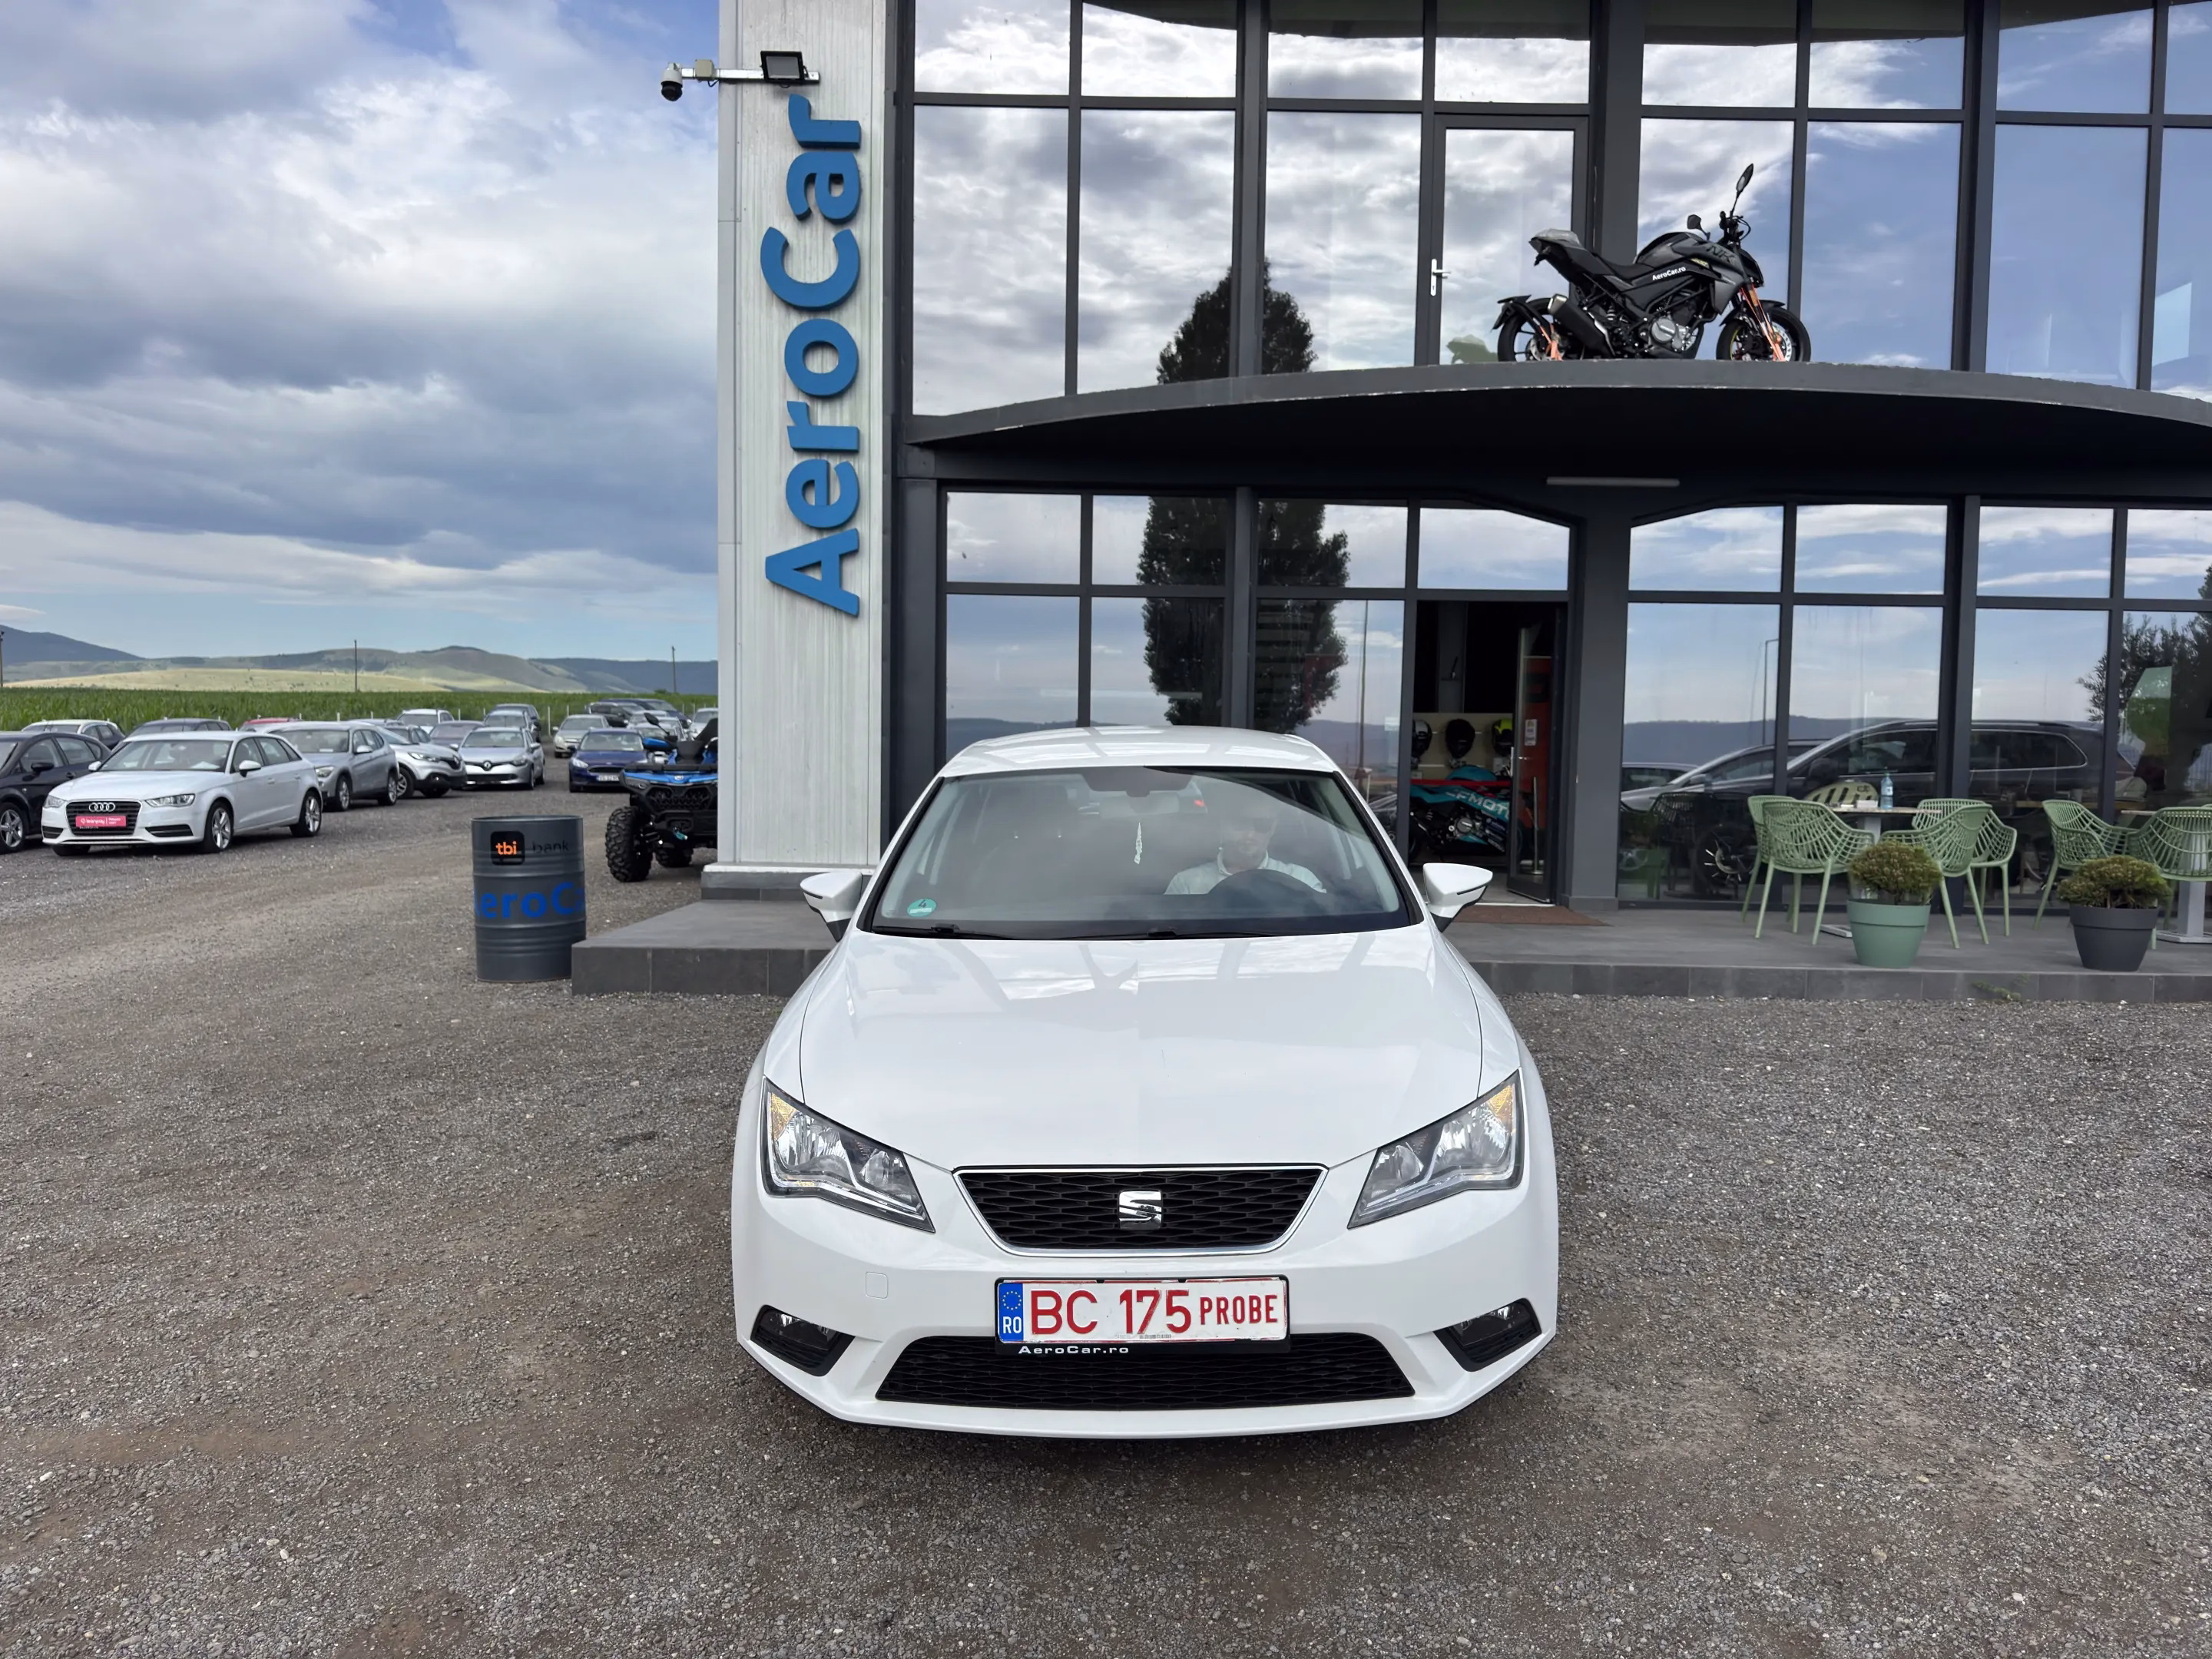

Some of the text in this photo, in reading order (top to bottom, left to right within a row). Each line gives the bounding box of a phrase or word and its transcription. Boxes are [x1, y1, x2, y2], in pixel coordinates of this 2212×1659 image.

[1652, 267, 1686, 280] AeroCar.ro
[760, 93, 861, 617] AeroCar
[495, 839, 570, 855] tbi bank
[1031, 1290, 1278, 1335] BC 175 PROBE
[1002, 1316, 1022, 1334] RO
[1018, 1345, 1129, 1355] AeroCar.ro
